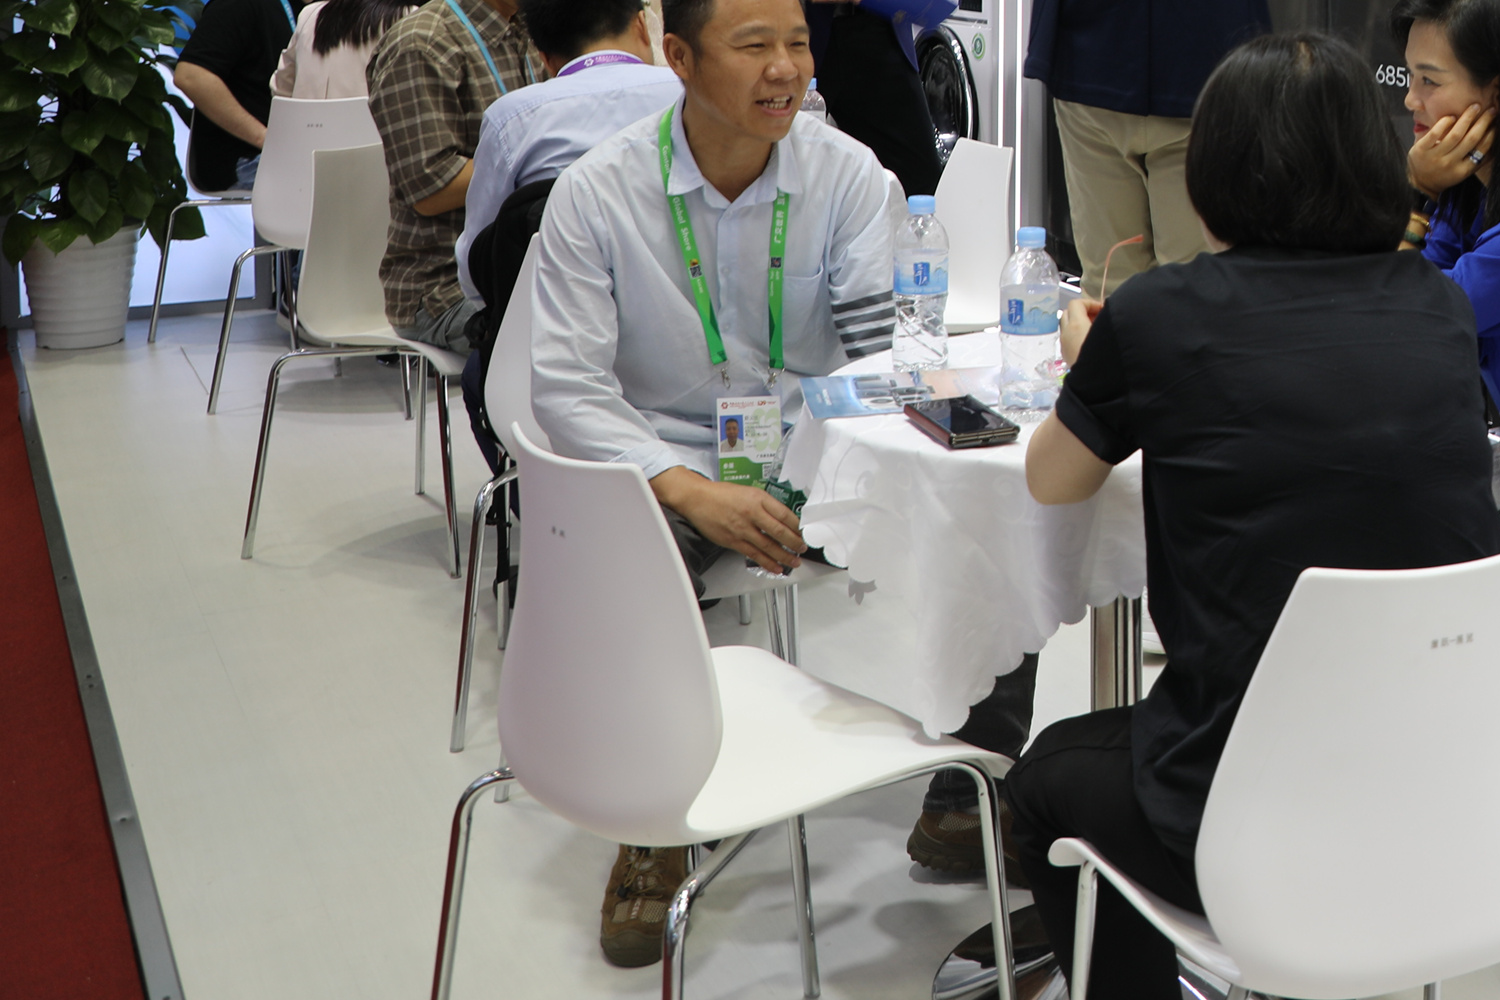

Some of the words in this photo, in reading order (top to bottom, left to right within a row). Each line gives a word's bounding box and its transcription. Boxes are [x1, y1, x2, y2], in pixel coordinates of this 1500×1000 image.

[1375, 64, 1410, 88] 685
[672, 196, 686, 225] Global
[680, 228, 692, 251] Share
